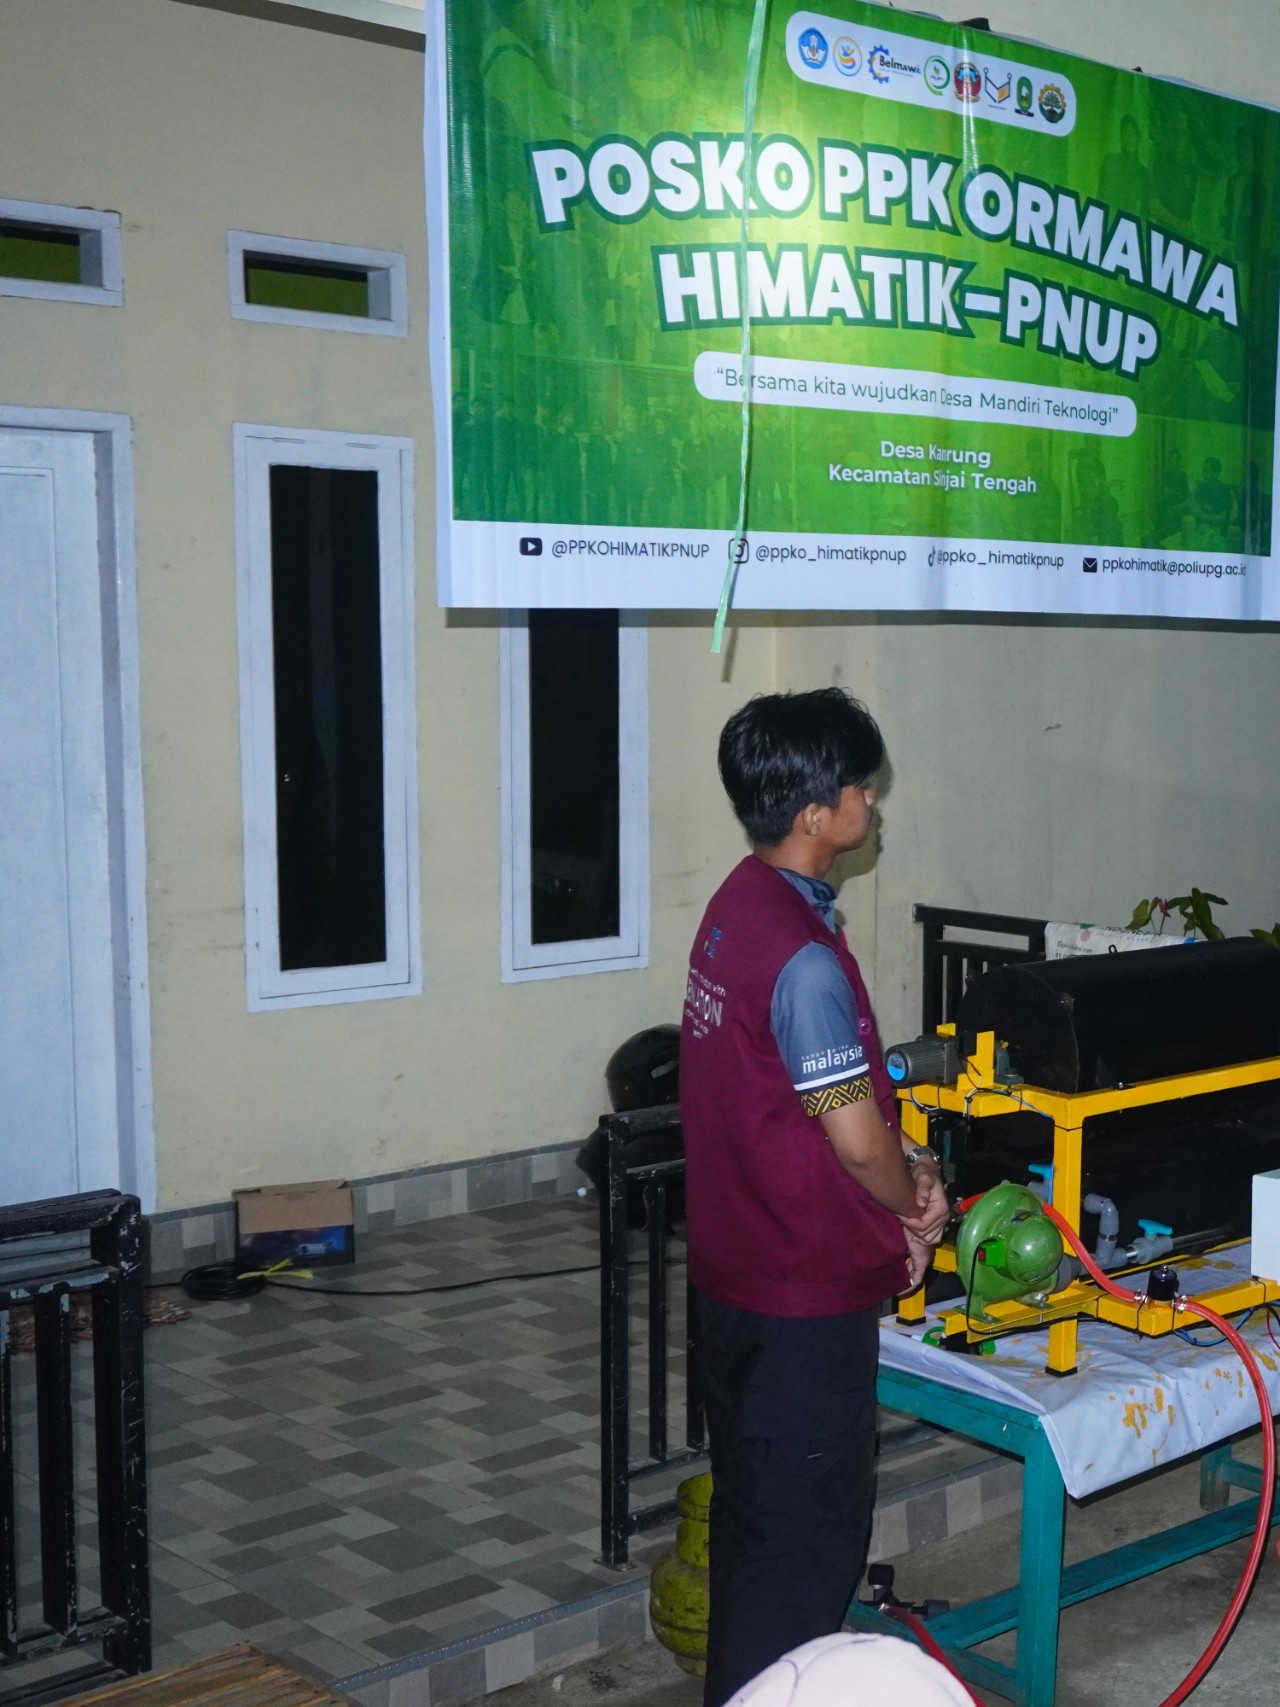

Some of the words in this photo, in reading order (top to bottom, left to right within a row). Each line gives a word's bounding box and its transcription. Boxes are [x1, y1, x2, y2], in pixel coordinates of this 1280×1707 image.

[532, 140, 811, 224] POSKO
[824, 146, 954, 227] PPK
[964, 171, 1239, 327] ORMAWA
[814, 375, 847, 396] kita
[851, 382, 937, 403] wujudkan
[980, 392, 1041, 414] Mandiri
[880, 440, 924, 459] Desa
[828, 464, 930, 486] Kecamatan
[933, 469, 966, 491] Sinjai
[971, 472, 1037, 495] Tengah
[551, 539, 710, 558] @PPKOHIMATIKPNUP
[755, 544, 908, 565] @ppko_himatikpnup
[936, 549, 1065, 570] @ppko_himatikpnup
[803, 1045, 863, 1074] malaysia
